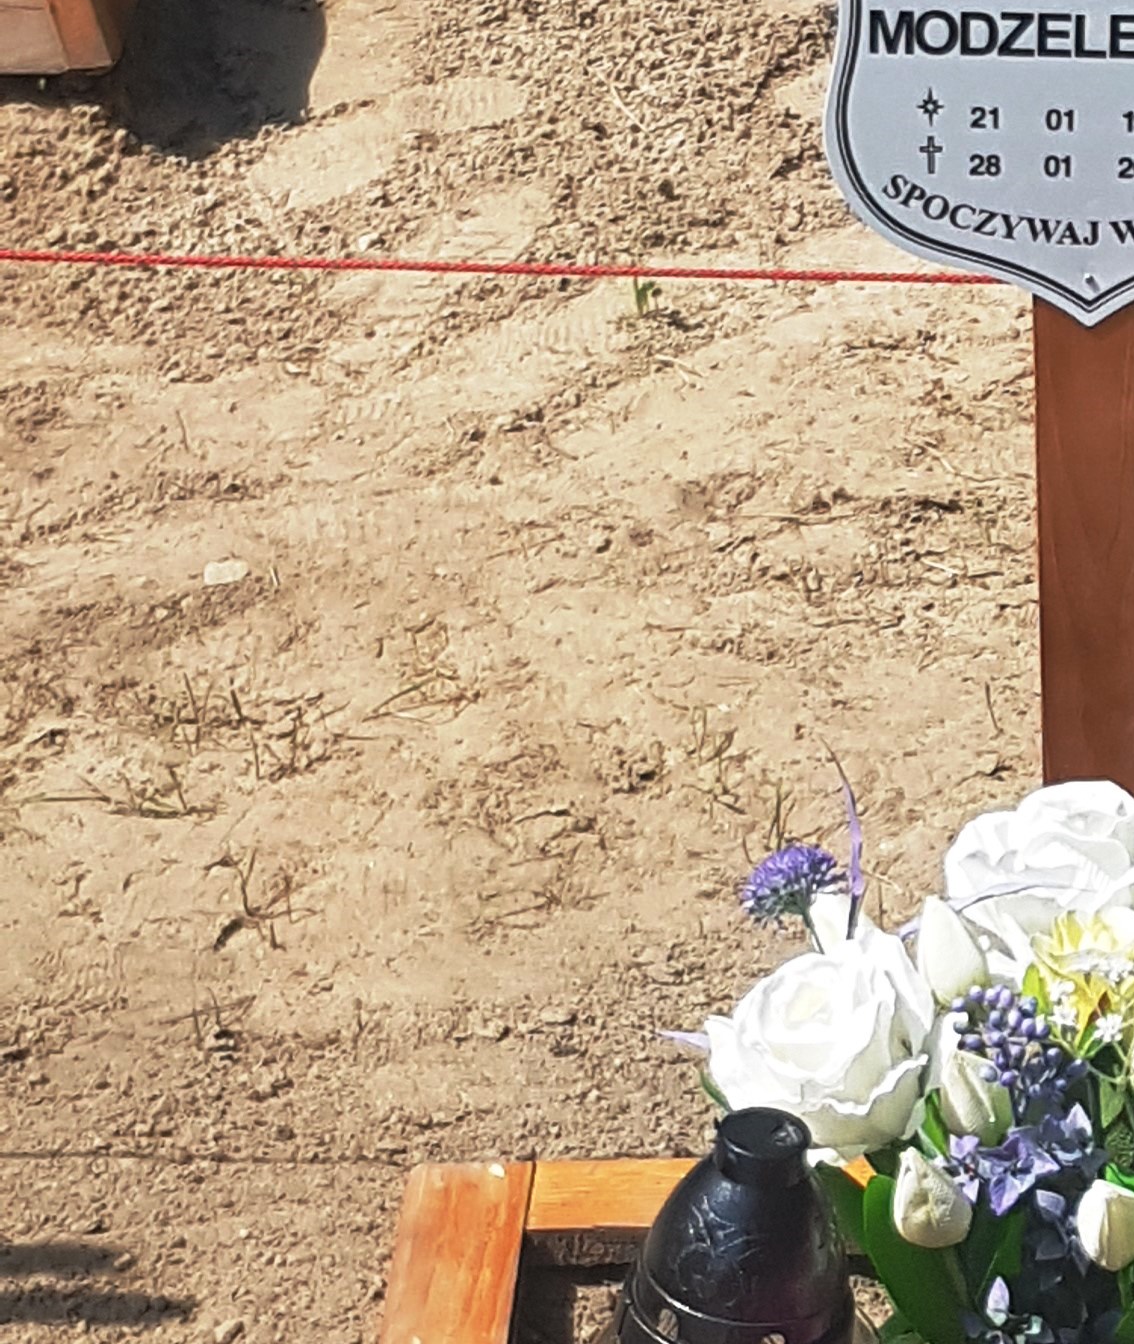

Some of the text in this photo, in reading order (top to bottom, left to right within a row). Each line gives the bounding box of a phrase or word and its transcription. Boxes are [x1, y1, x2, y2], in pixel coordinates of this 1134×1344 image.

[969, 106, 1000, 130] 21
[1044, 108, 1075, 132] 01
[968, 152, 1001, 177] 28
[1043, 154, 1072, 178] 01
[881, 174, 1100, 246] SPOCZYWAJ
